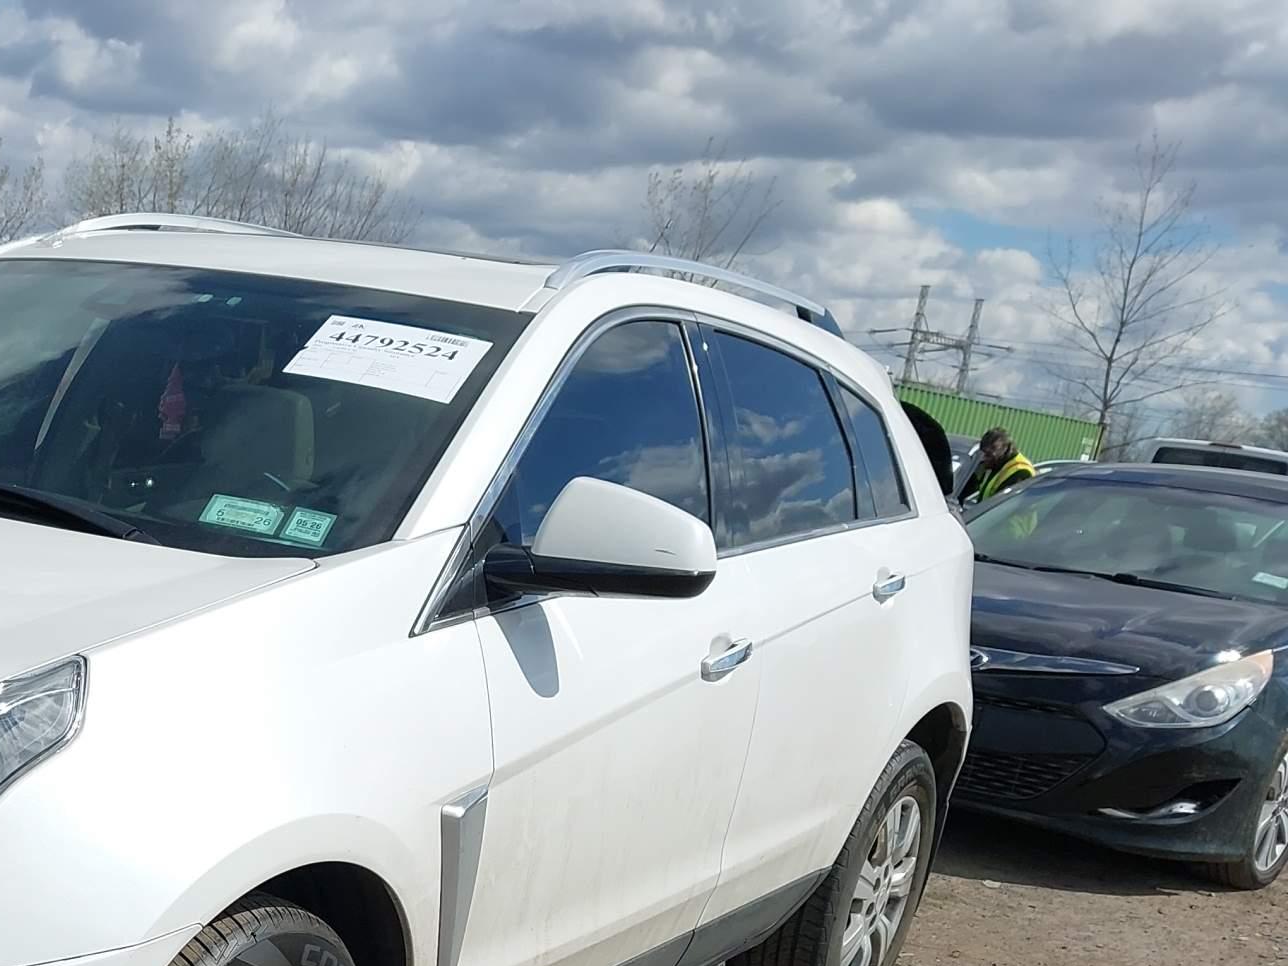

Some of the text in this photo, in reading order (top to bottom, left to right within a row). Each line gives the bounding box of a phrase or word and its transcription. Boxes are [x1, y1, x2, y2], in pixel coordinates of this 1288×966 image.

[329, 331, 459, 361] 44792524
[254, 516, 271, 527] 26
[310, 521, 322, 530] 26
